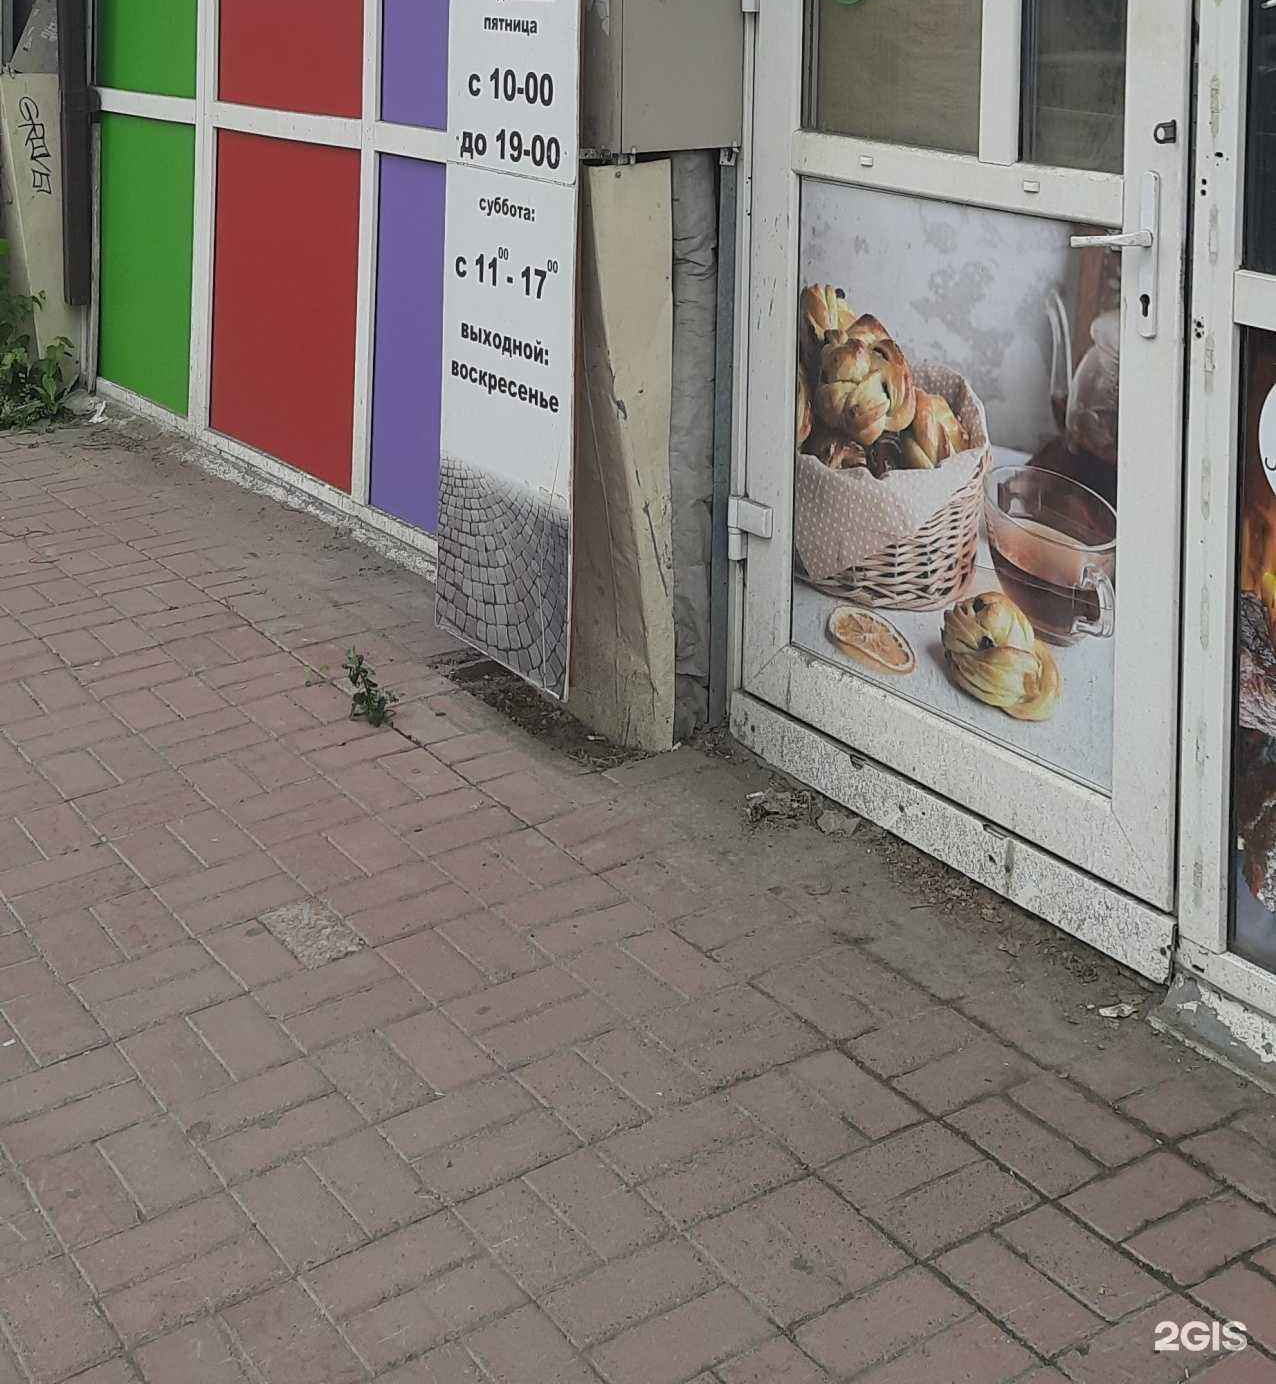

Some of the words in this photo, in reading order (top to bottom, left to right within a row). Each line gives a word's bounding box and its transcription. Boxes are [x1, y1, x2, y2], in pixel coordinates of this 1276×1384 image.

[483, 16, 538, 36] пятница
[489, 67, 554, 107] 10-00
[459, 131, 487, 160] до
[495, 128, 561, 170] 19-00
[479, 196, 535, 222] суббота:
[460, 322, 549, 366] выходной:
[451, 359, 559, 414] воскресенье
